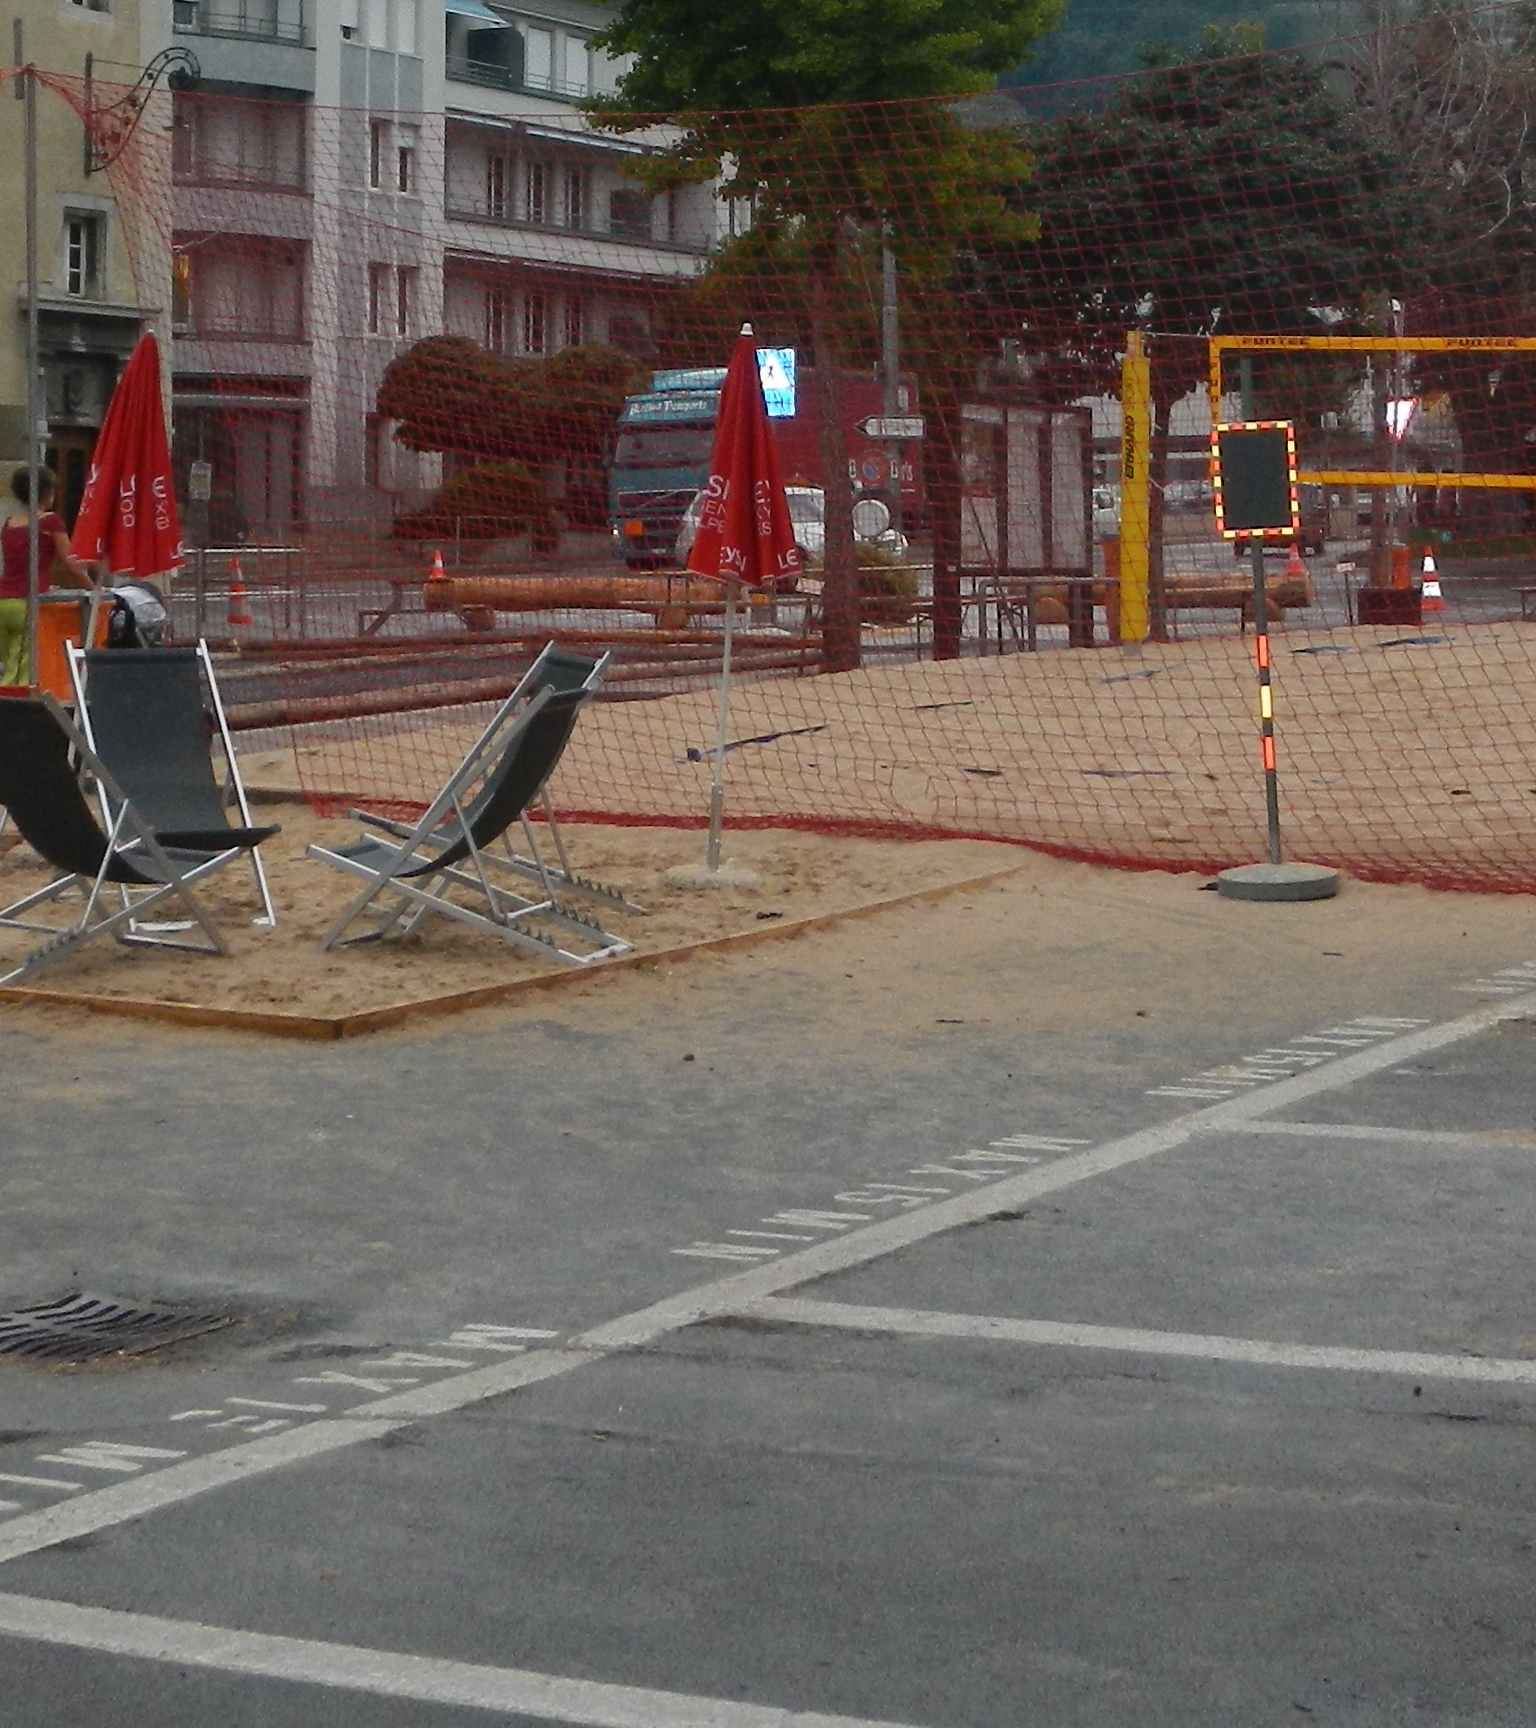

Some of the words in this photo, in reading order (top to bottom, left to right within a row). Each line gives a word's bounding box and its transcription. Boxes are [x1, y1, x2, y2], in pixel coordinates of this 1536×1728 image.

[907, 1132, 1093, 1182] MAX
[833, 1181, 952, 1209] 15
[668, 1207, 873, 1263] MIN
[291, 1322, 561, 1394] MAX
